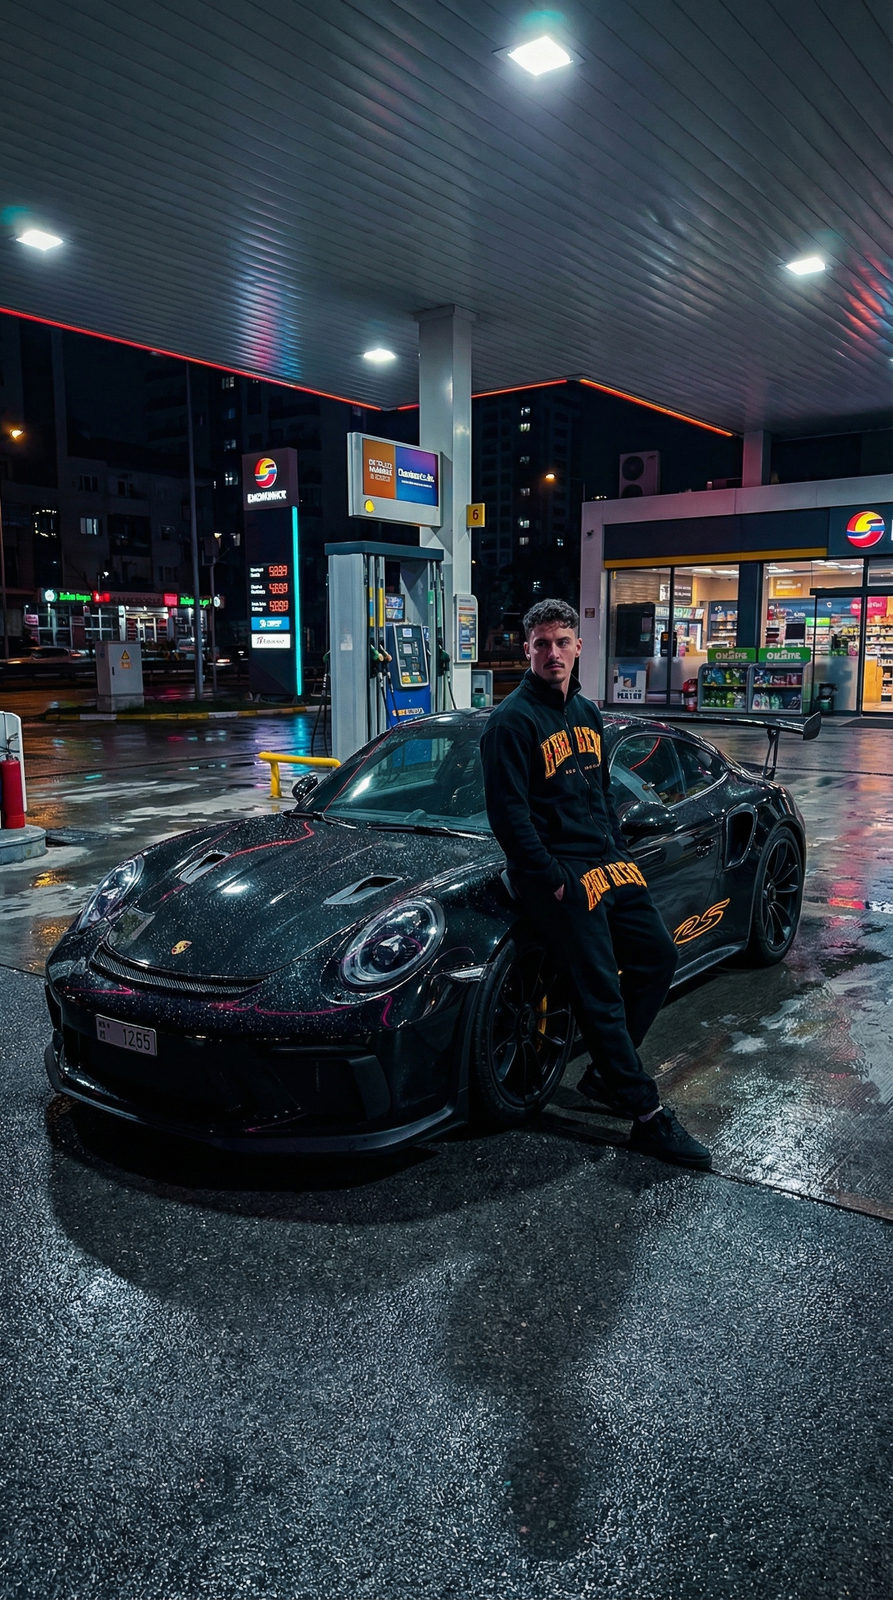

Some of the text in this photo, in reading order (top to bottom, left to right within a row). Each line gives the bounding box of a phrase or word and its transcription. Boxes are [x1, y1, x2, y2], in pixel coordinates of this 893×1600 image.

[472, 509, 479, 520] 6
[673, 898, 730, 944] RS
[122, 1028, 151, 1051] 1265
